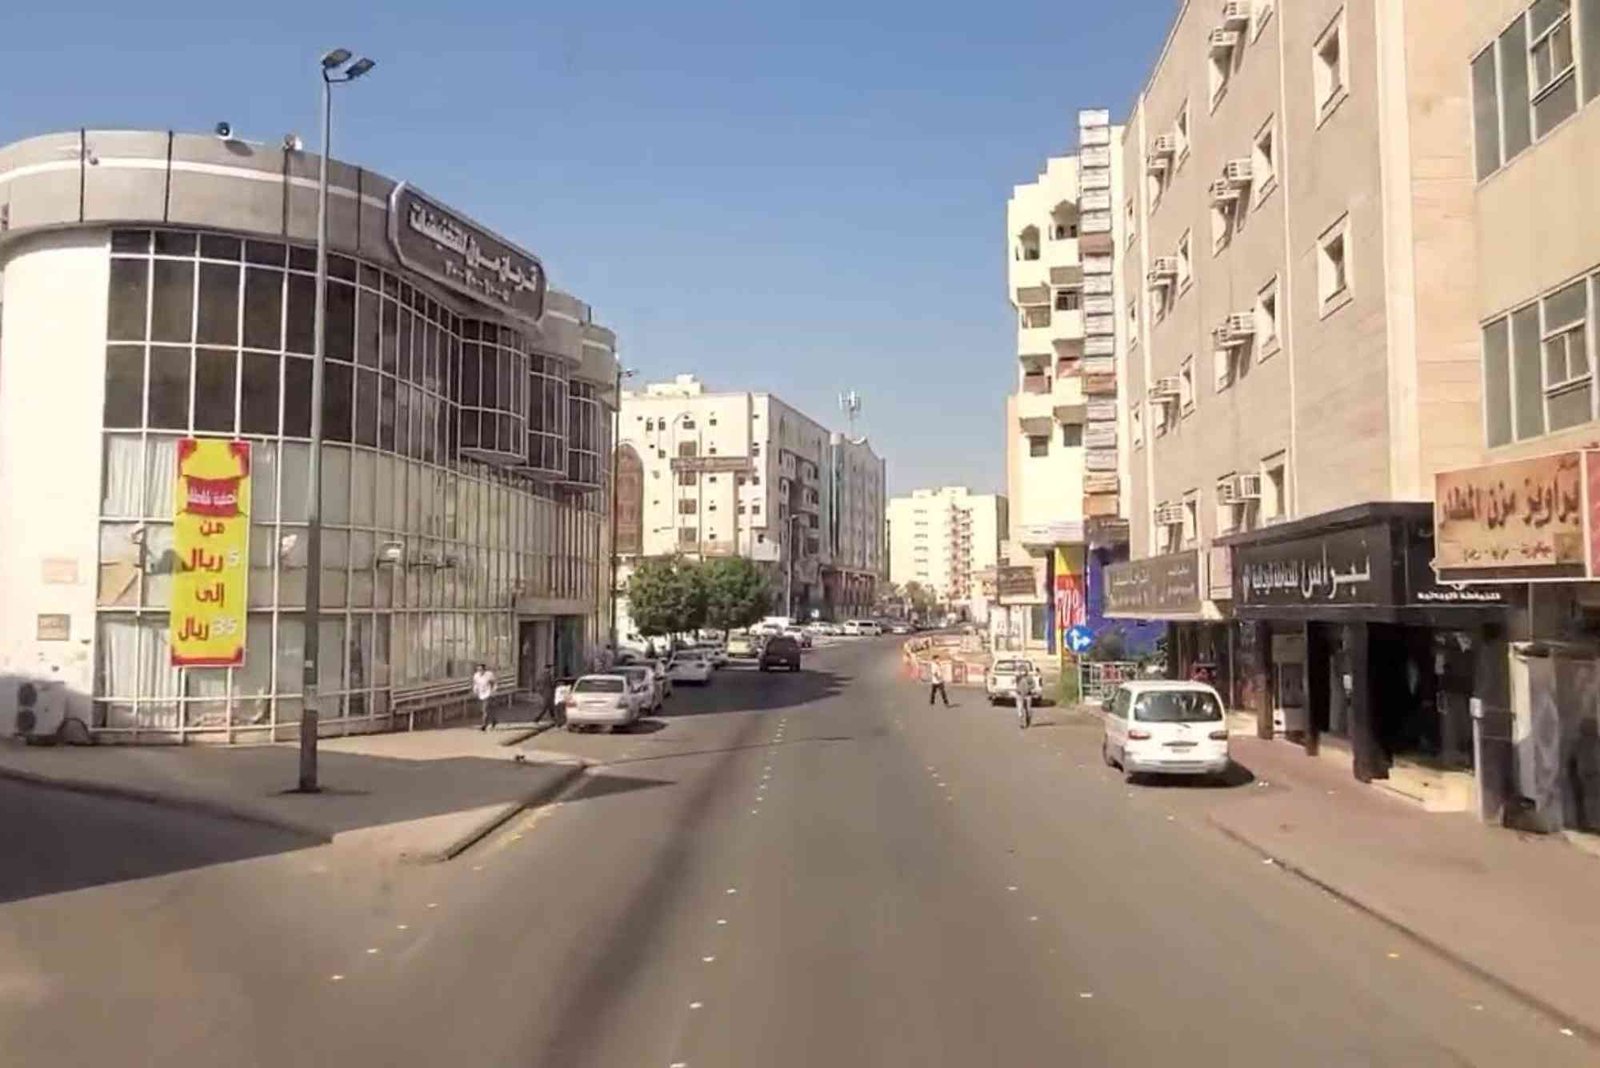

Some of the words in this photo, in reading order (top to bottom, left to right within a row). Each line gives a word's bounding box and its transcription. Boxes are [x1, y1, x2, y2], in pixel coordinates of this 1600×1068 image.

[200, 520, 225, 537] من
[181, 547, 224, 573] ريال
[196, 582, 225, 608] إلى
[178, 616, 209, 642] ريال
